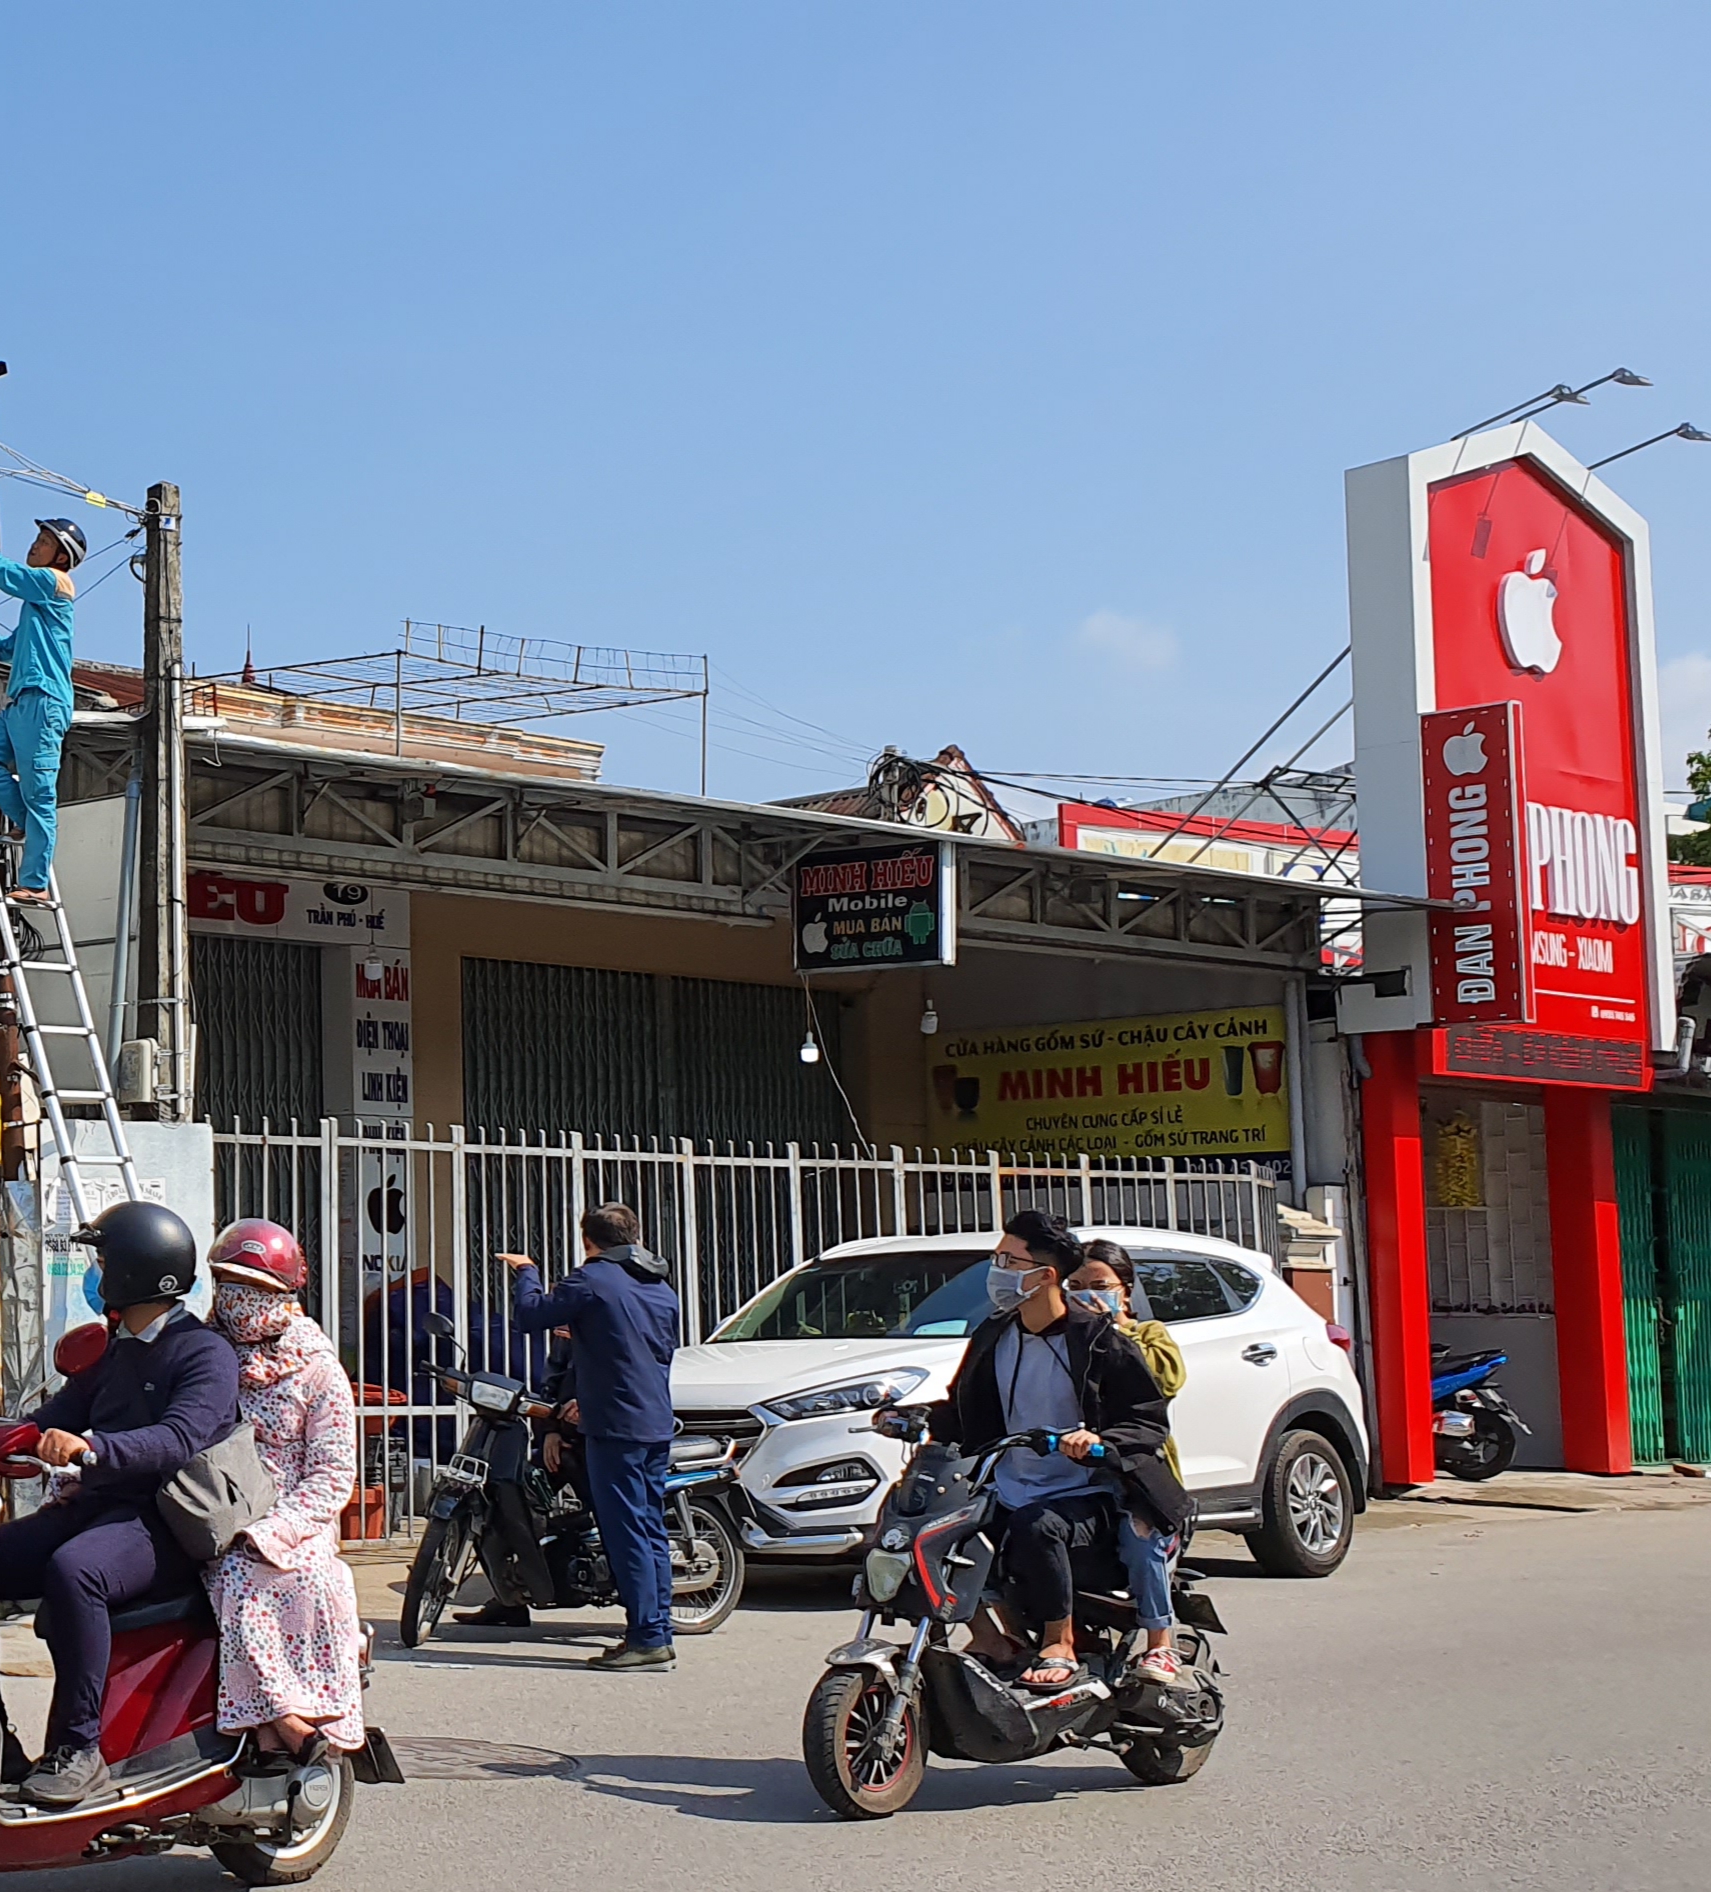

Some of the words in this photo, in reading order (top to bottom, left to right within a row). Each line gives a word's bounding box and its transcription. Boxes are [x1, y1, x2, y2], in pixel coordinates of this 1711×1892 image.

[1448, 783, 1492, 913] PHONG
[1526, 801, 1640, 925] PHONG
[800, 862, 867, 897] MINH
[870, 847, 935, 891] HIẾU
[306, 902, 334, 926] TRẦN
[337, 908, 357, 928] PHÚ
[366, 908, 386, 930] HUẾ
[828, 893, 908, 913] Mobile
[833, 919, 866, 936] MUA
[870, 914, 902, 933] BÁN
[1454, 923, 1496, 1004] ĐAN
[1576, 936, 1614, 974] XIAOMI
[384, 959, 409, 1001] BÁN
[945, 1041, 979, 1058] CỬA
[983, 1036, 1031, 1054] HÀNG
[1034, 1029, 1074, 1052] GỐM
[1079, 1029, 1105, 1049] SỨ
[1117, 1024, 1169, 1047] CHẬU
[1173, 1021, 1210, 1043] CÂY
[1213, 1017, 1268, 1039] CẢNH
[362, 1072, 384, 1102] LINH
[998, 1064, 1103, 1101] MINH
[1117, 1048, 1211, 1096] HIẾU
[1020, 1134, 1056, 1152] CẢNH
[1059, 1134, 1084, 1151] CÁC
[1087, 1135, 1117, 1153] LOẠI
[1135, 1128, 1165, 1148] GỐM
[1168, 1129, 1188, 1146] SỨ
[1191, 1128, 1239, 1145] TRANG
[1242, 1124, 1267, 1142] TRÍ
[1025, 1111, 1079, 1132] CHUYÊN
[1082, 1113, 1118, 1130] CUNG
[1121, 1106, 1148, 1127] CẤP
